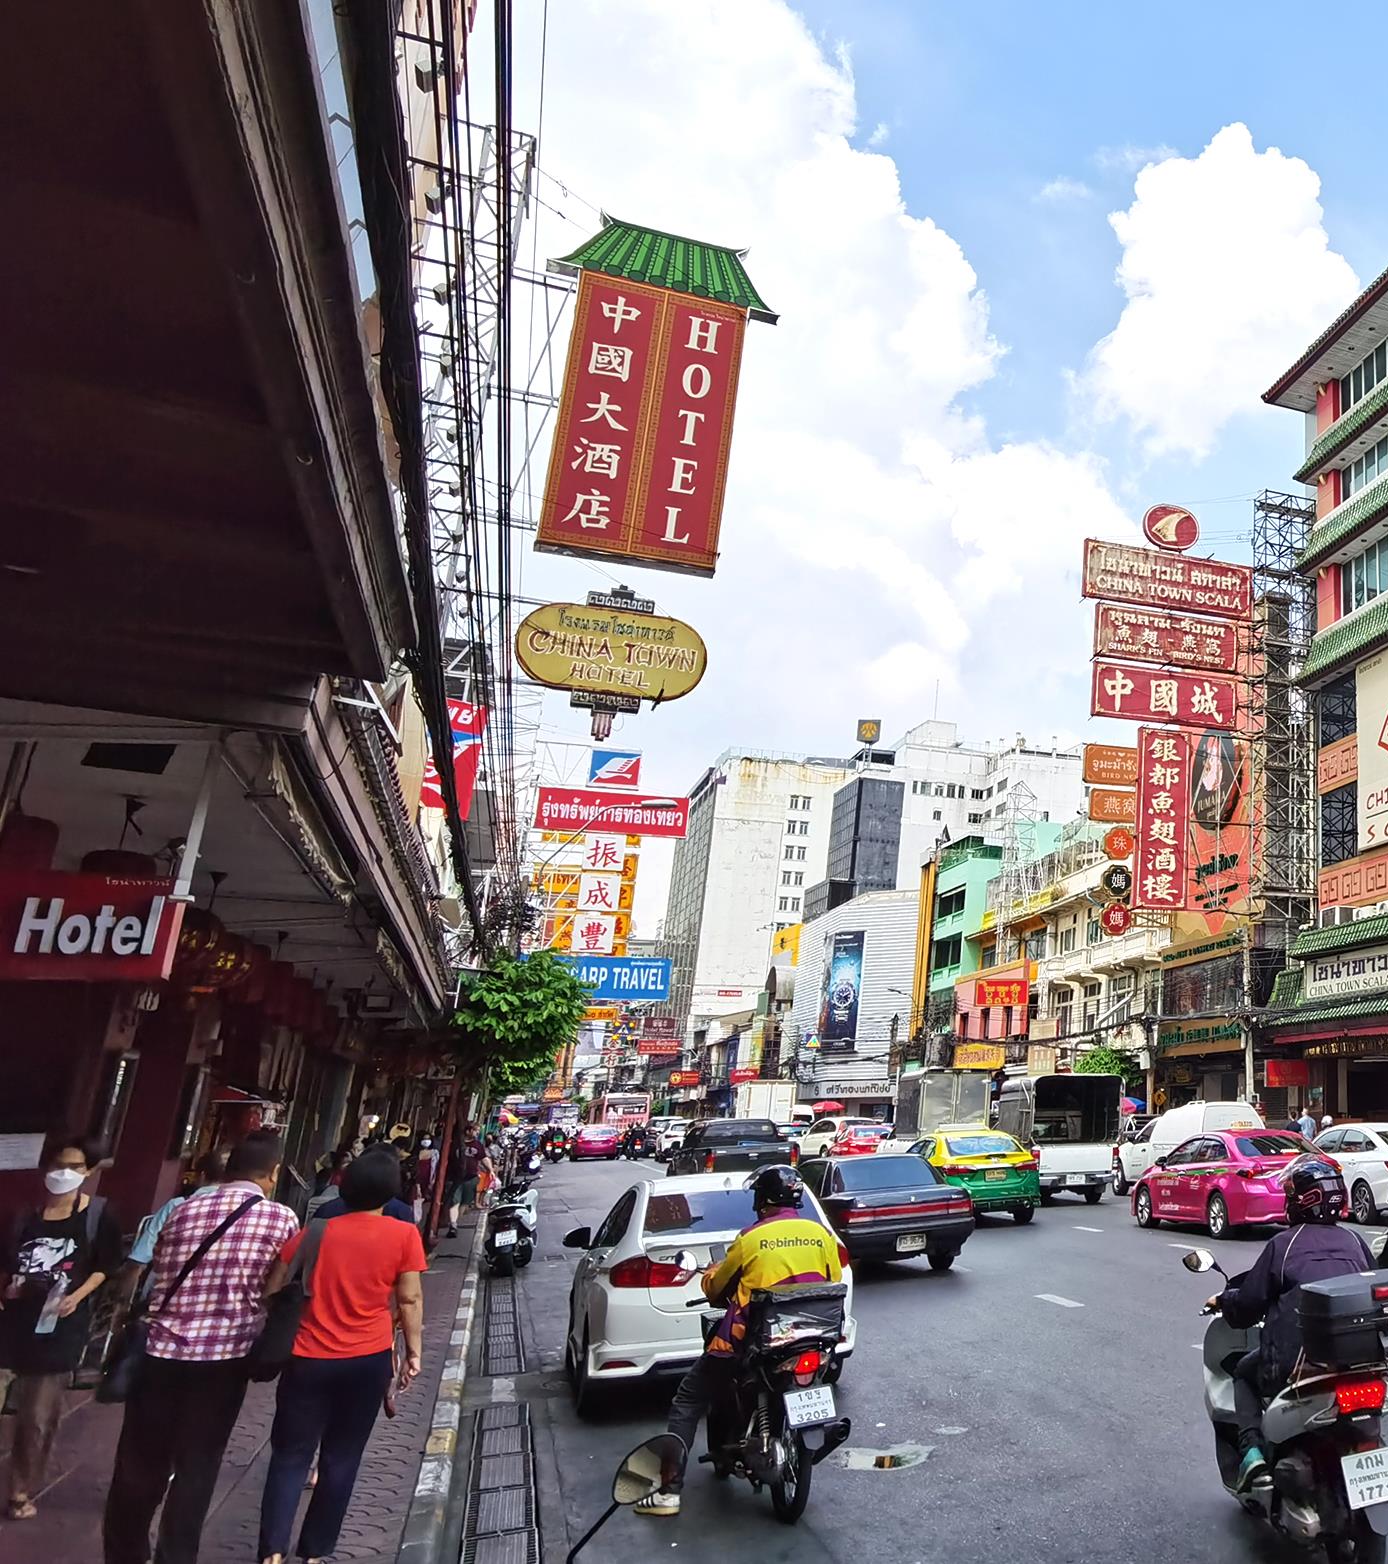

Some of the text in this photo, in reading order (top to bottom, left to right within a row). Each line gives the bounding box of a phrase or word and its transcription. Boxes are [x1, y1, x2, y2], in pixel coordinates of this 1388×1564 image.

[561, 295, 641, 530] 中國大酒店
[660, 314, 720, 545] HOTEL
[1096, 575, 1242, 610] CHINA TOWN SCALA
[527, 629, 698, 674] CHINA TOWN
[1108, 641, 1146, 655] SHARK'S
[1148, 647, 1163, 657] FIN
[1172, 651, 1201, 663] BIRD'S
[1203, 656, 1226, 665] NEST
[570, 661, 650, 689] HOTEL
[1103, 670, 1223, 724] 中國城
[1142, 737, 1182, 902] 銀都魚翅酒樓
[1112, 836, 1128, 850] 珠
[580, 839, 622, 951] 振成豐
[14, 895, 165, 956] Hotel
[612, 967, 665, 991] TRAVEL
[1309, 984, 1334, 998] CHINA
[1336, 979, 1361, 993] TOWN
[797, 1408, 829, 1422] 3205
[1355, 1453, 1384, 1470] 4กม
